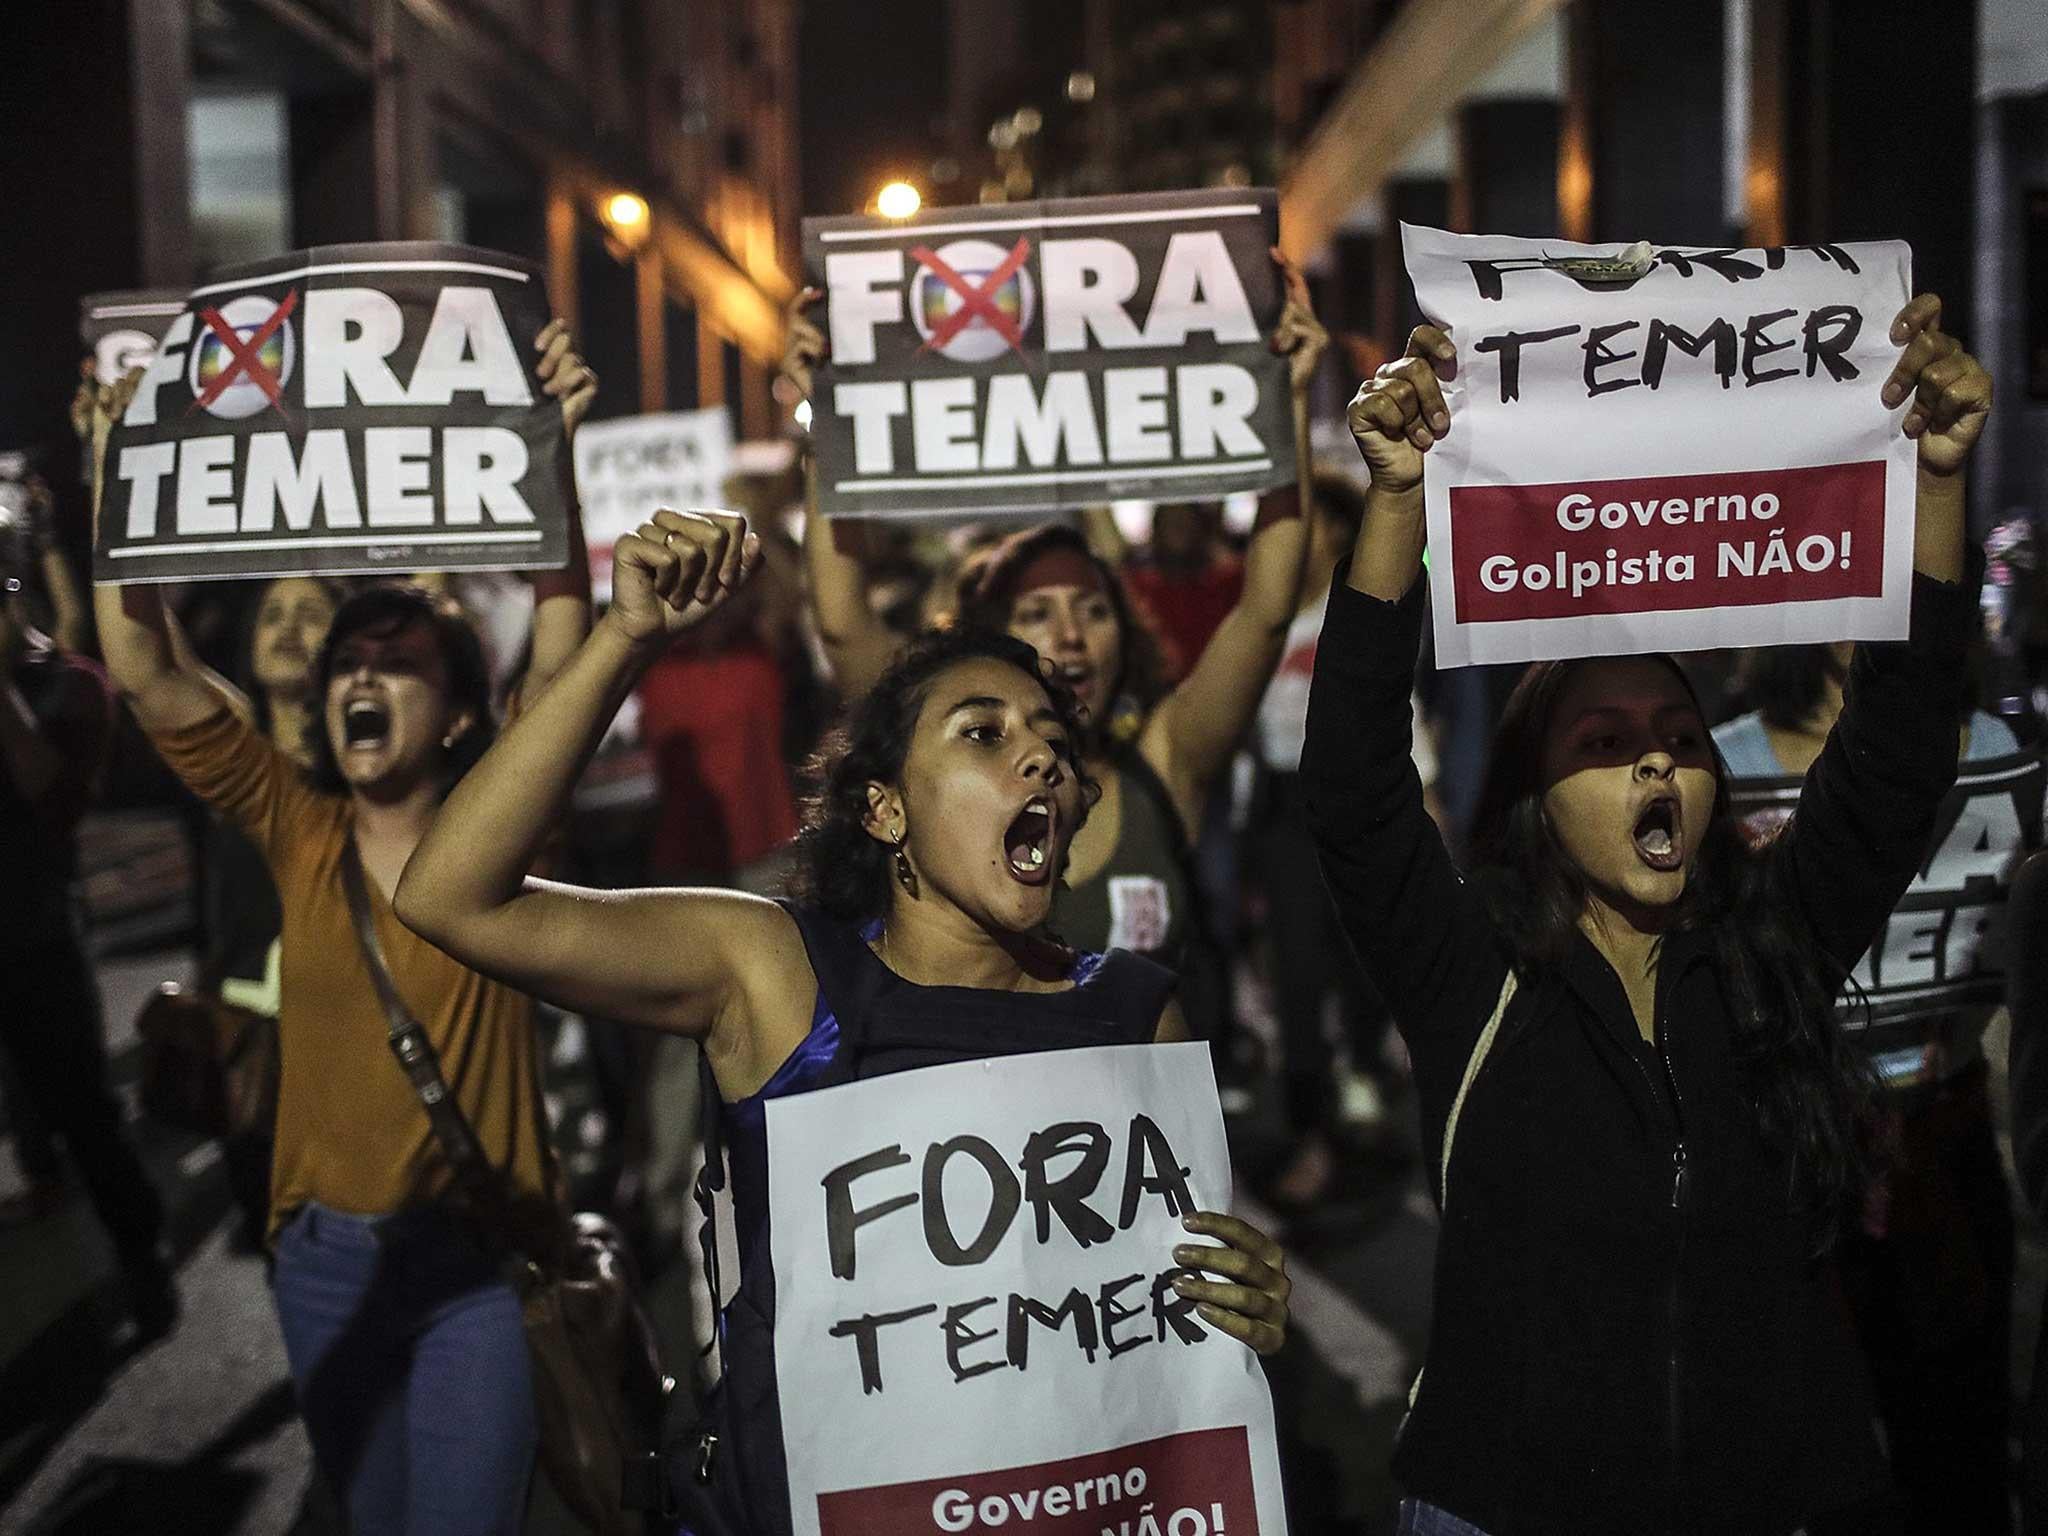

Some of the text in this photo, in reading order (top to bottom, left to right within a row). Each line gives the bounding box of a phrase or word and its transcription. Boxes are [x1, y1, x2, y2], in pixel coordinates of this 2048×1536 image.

[1474, 304, 1864, 403] TEMER
[833, 362, 1267, 475] TEMER
[117, 426, 536, 539] TEMER
[1556, 492, 1781, 532] Governo
[1478, 527, 1853, 598] Golpista NÃO!
[820, 1112, 1199, 1282] FORA
[827, 1266, 1209, 1395] TEMER
[931, 1466, 1148, 1533] Governo
